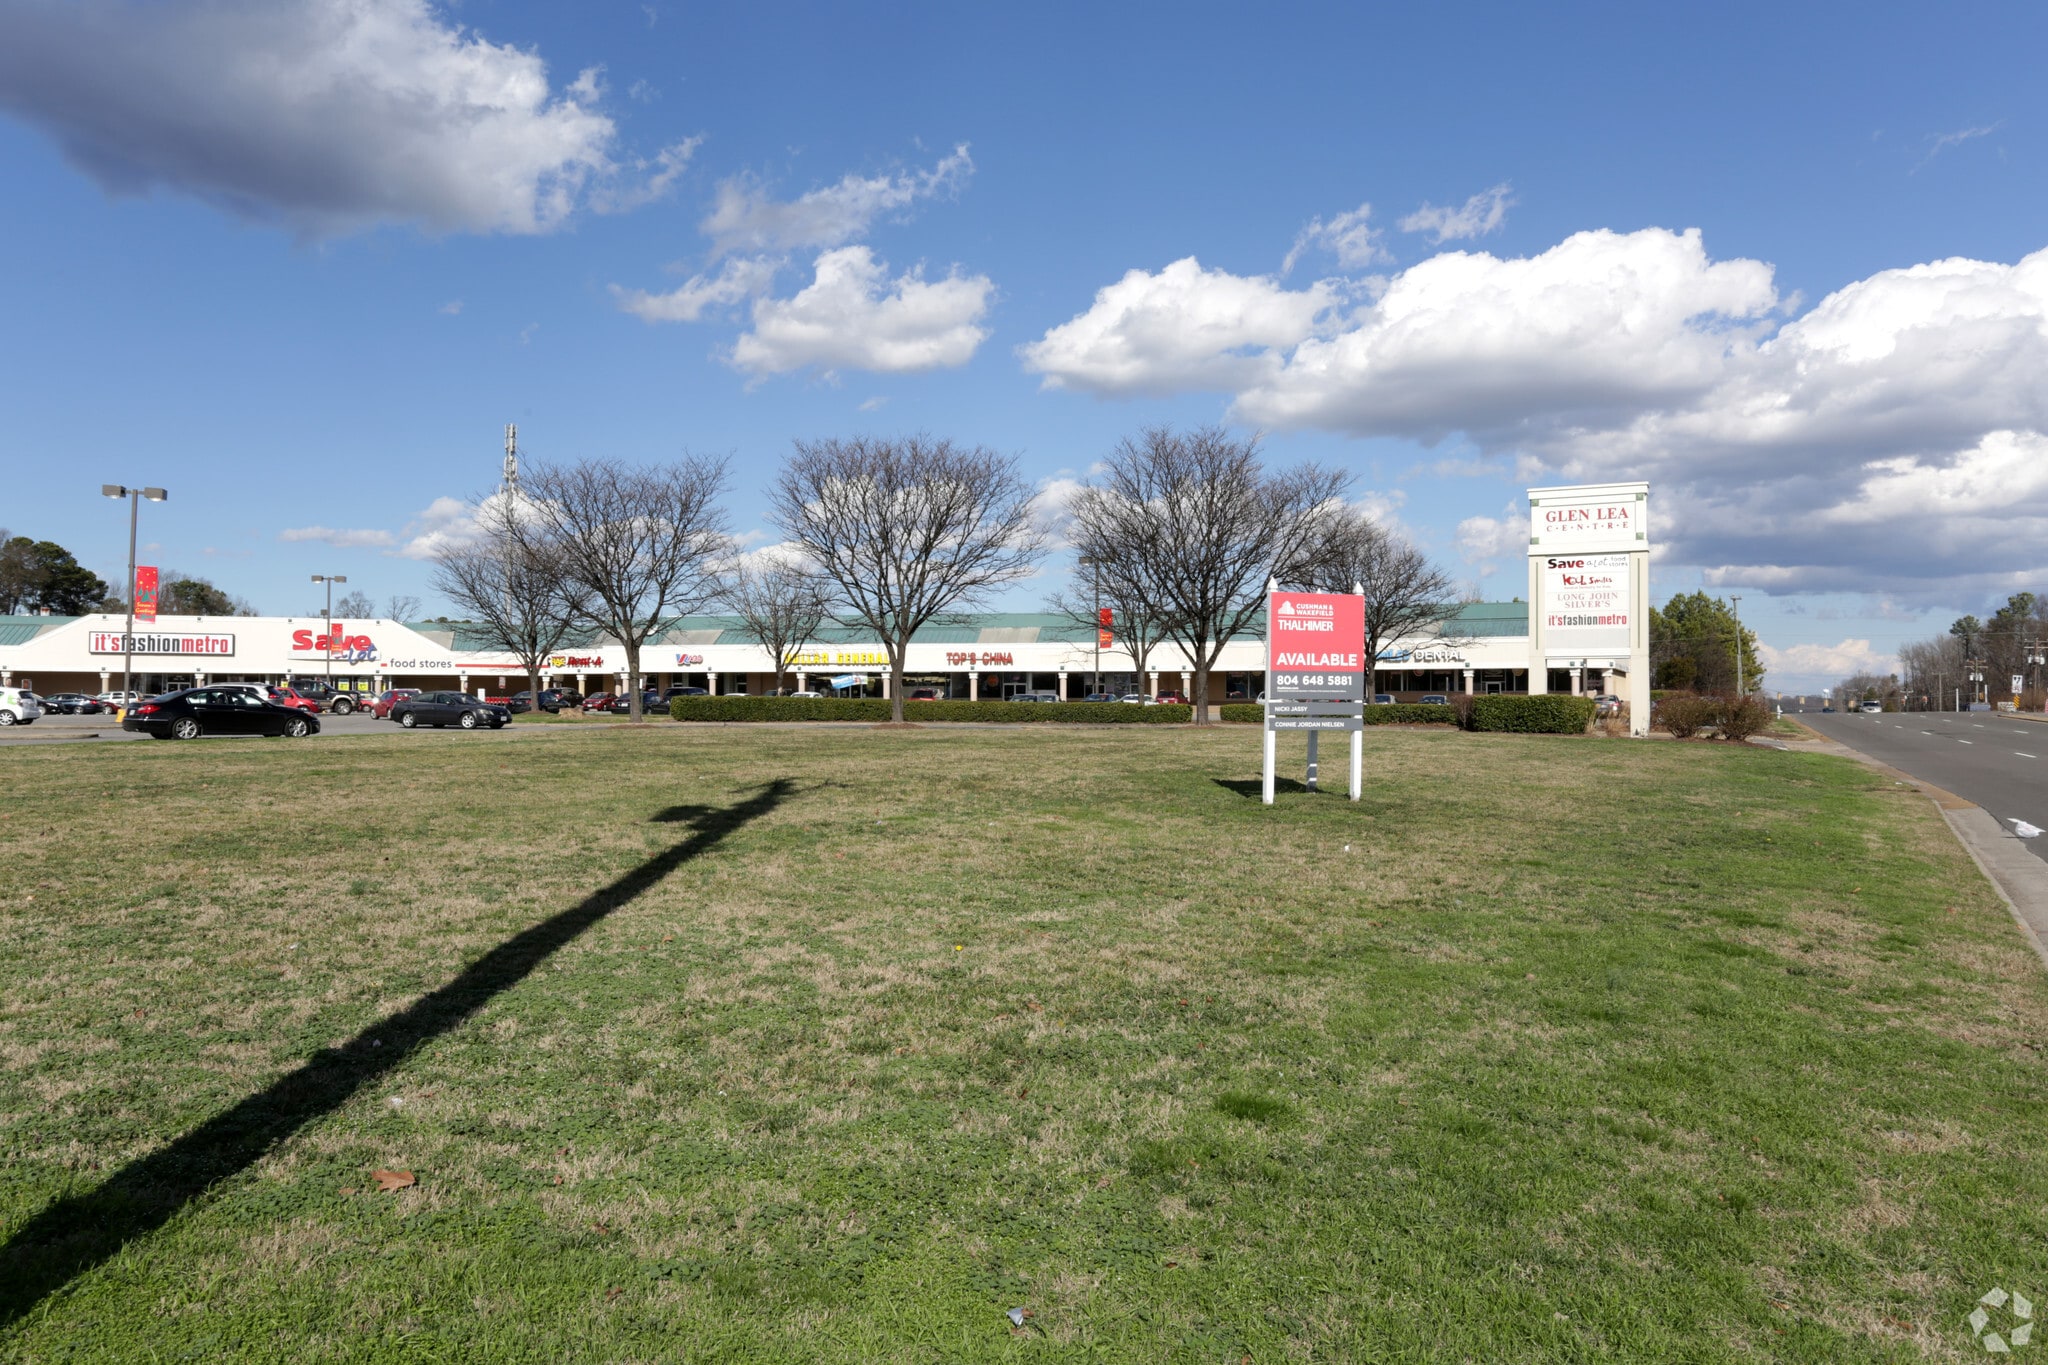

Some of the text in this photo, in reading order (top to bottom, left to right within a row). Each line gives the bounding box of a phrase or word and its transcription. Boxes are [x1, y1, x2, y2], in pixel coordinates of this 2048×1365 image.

[1545, 507, 1629, 523] GLEN LEA
[1547, 558, 1585, 569] Save
[1557, 592, 1618, 601] LONG JOHN
[1564, 600, 1611, 608] SILVER'S
[1296, 609, 1334, 617] WAKEFIELD
[1277, 619, 1334, 632] THALHIMER
[836, 652, 890, 665] GENERAL
[946, 652, 1014, 666] TOP'S CHINA
[1276, 652, 1358, 666] AVAILABLE
[1414, 649, 1466, 662] DENTAL
[390, 658, 453, 668] food stores
[1276, 675, 1353, 686] 804 648 5881
